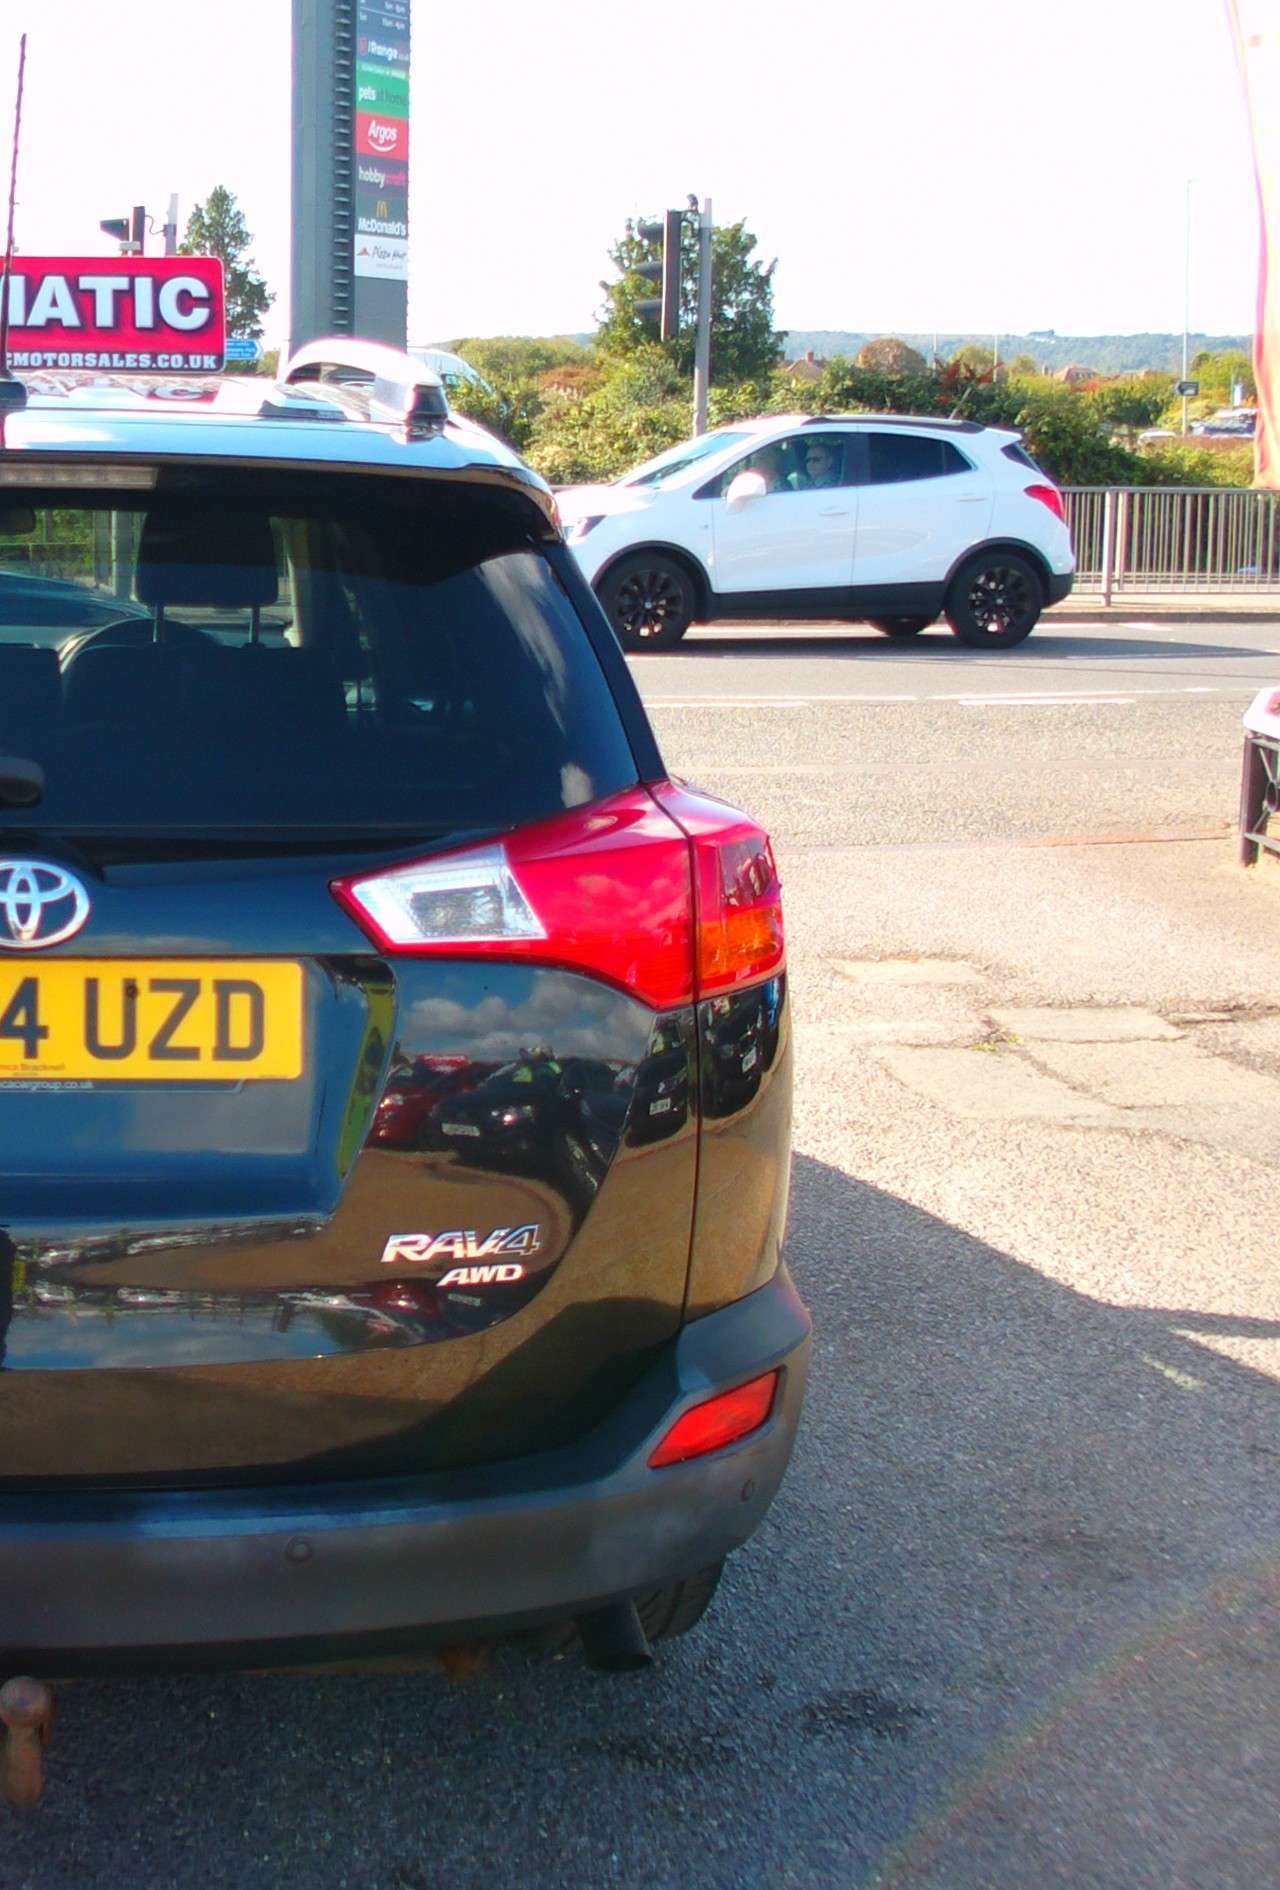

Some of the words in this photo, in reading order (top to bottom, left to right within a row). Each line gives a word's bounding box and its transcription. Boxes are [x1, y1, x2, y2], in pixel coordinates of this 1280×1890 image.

[368, 120, 397, 144] Argos
[358, 217, 406, 236] McDonald's
[84, 977, 265, 1061] UZD
[380, 1224, 541, 1263] RAV4
[436, 1264, 526, 1288] AWD
